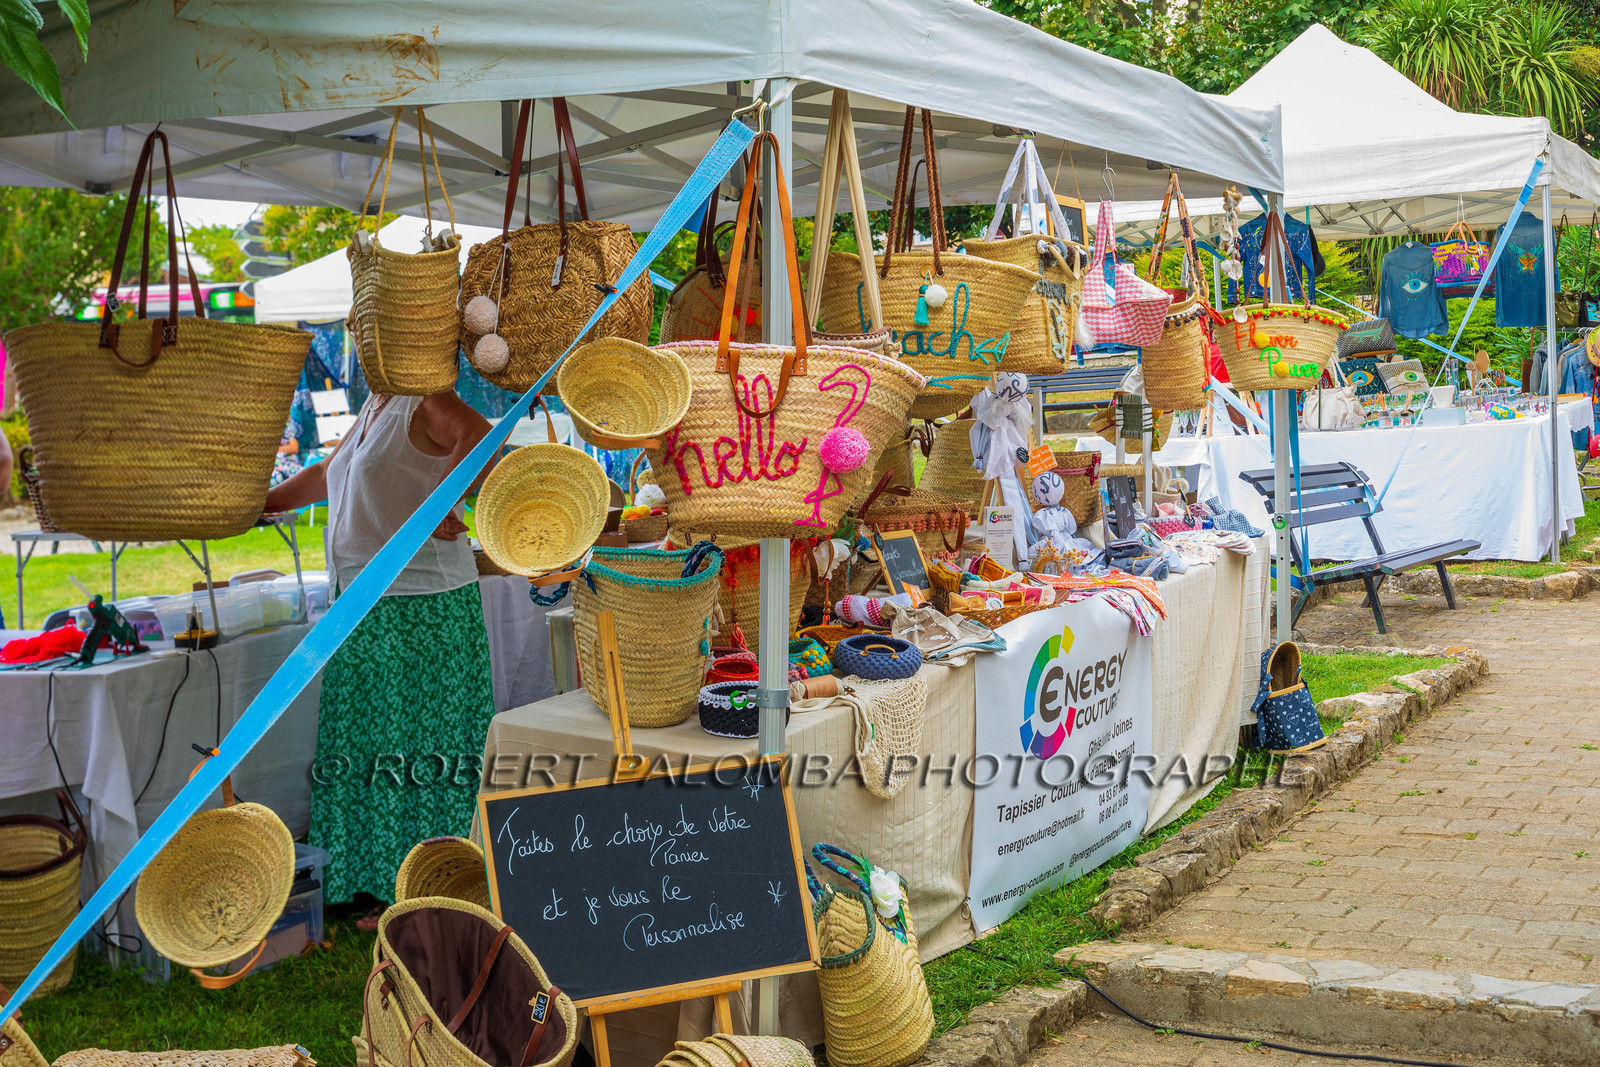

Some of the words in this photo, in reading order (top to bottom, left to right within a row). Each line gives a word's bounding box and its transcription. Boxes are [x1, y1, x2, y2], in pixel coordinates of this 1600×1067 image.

[1235, 319, 1298, 351] Flower
[1260, 347, 1321, 378] Power
[663, 373, 808, 495] hello
[1040, 648, 1127, 723] ENERGY
[1076, 688, 1121, 729] COUTUR
[1112, 717, 1133, 739] Joines
[571, 814, 592, 851] le
[606, 812, 663, 852] choix
[668, 804, 700, 837] de
[997, 793, 1047, 823] Tapissier
[998, 807, 1085, 856] energycouture@hotmail.fr
[543, 888, 567, 920] et
[583, 888, 601, 924] je
[661, 875, 691, 903] le
[981, 862, 1064, 908] www.energy-couture.com
[534, 996, 547, 1019] 20€
